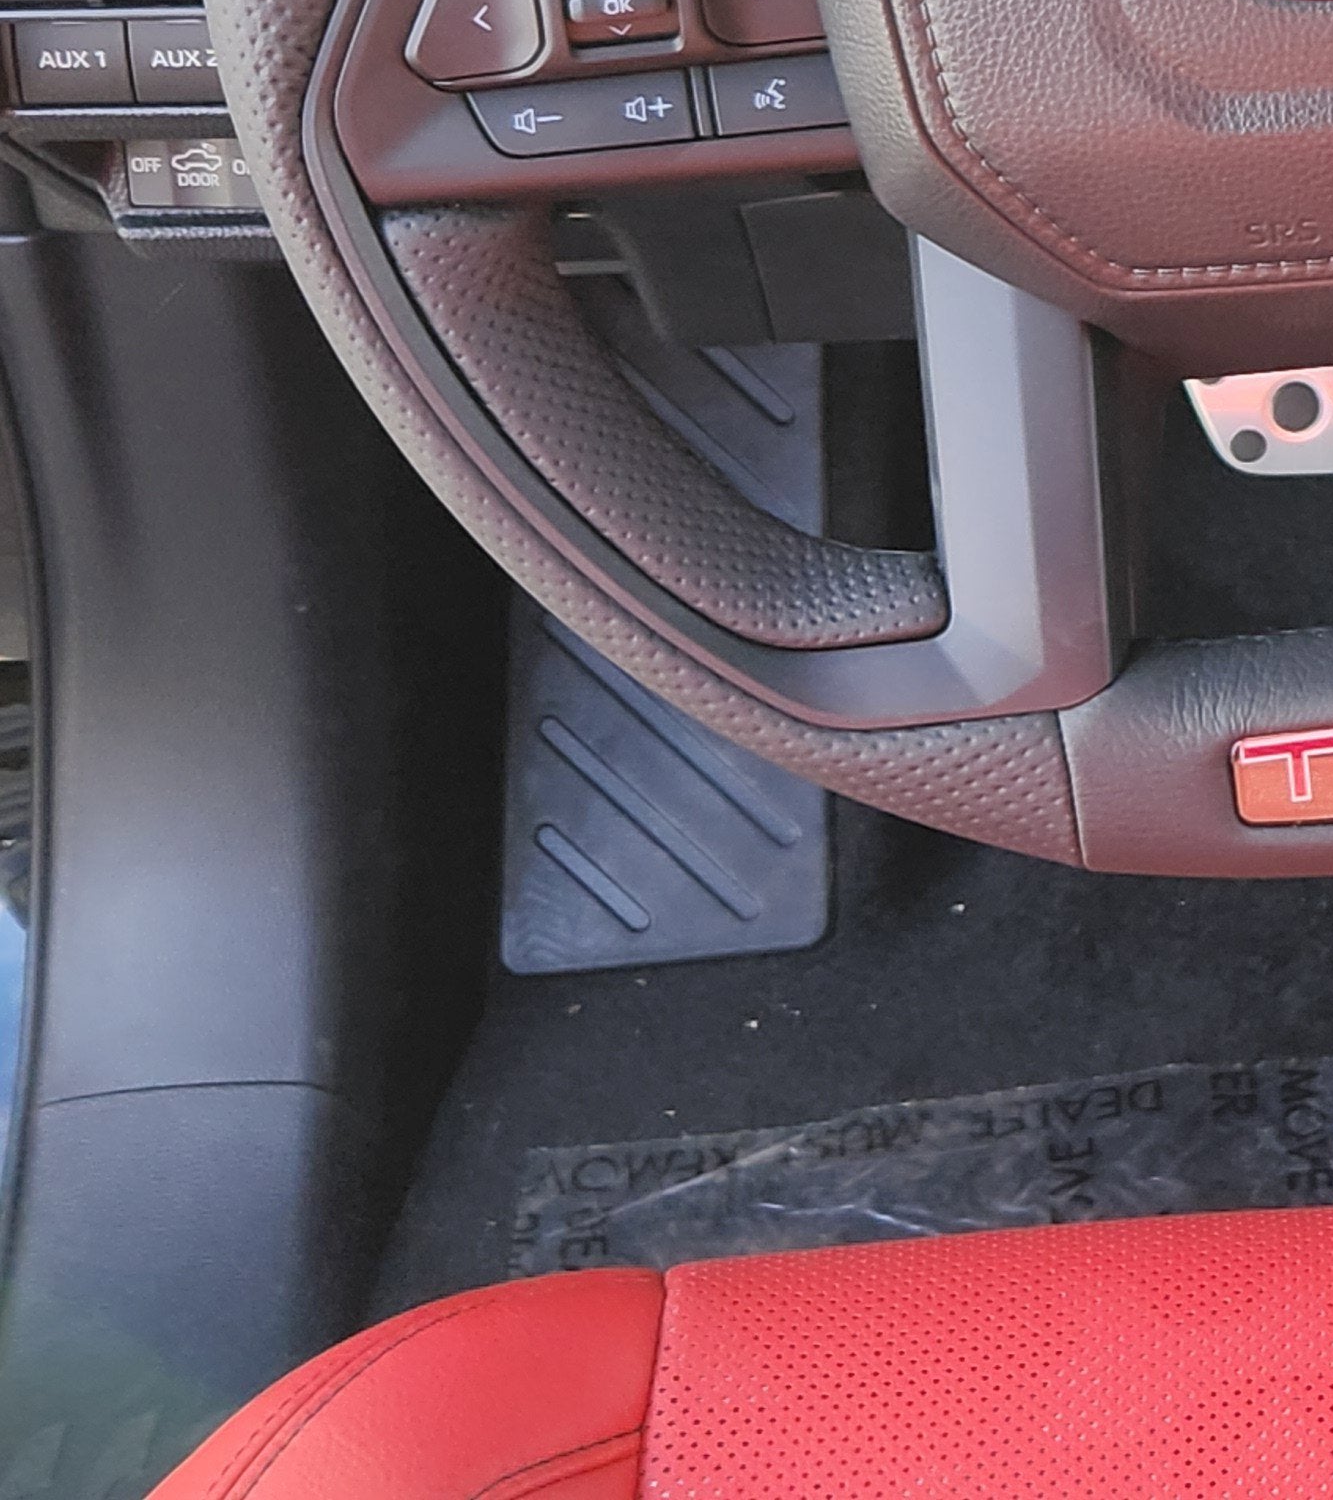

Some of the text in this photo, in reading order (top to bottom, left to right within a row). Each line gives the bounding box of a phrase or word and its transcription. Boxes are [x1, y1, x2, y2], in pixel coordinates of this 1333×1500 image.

[39, 49, 107, 69] AUX 1
[150, 49, 203, 69] AUX
[131, 157, 162, 173] OFF
[177, 172, 221, 187] DOOR
